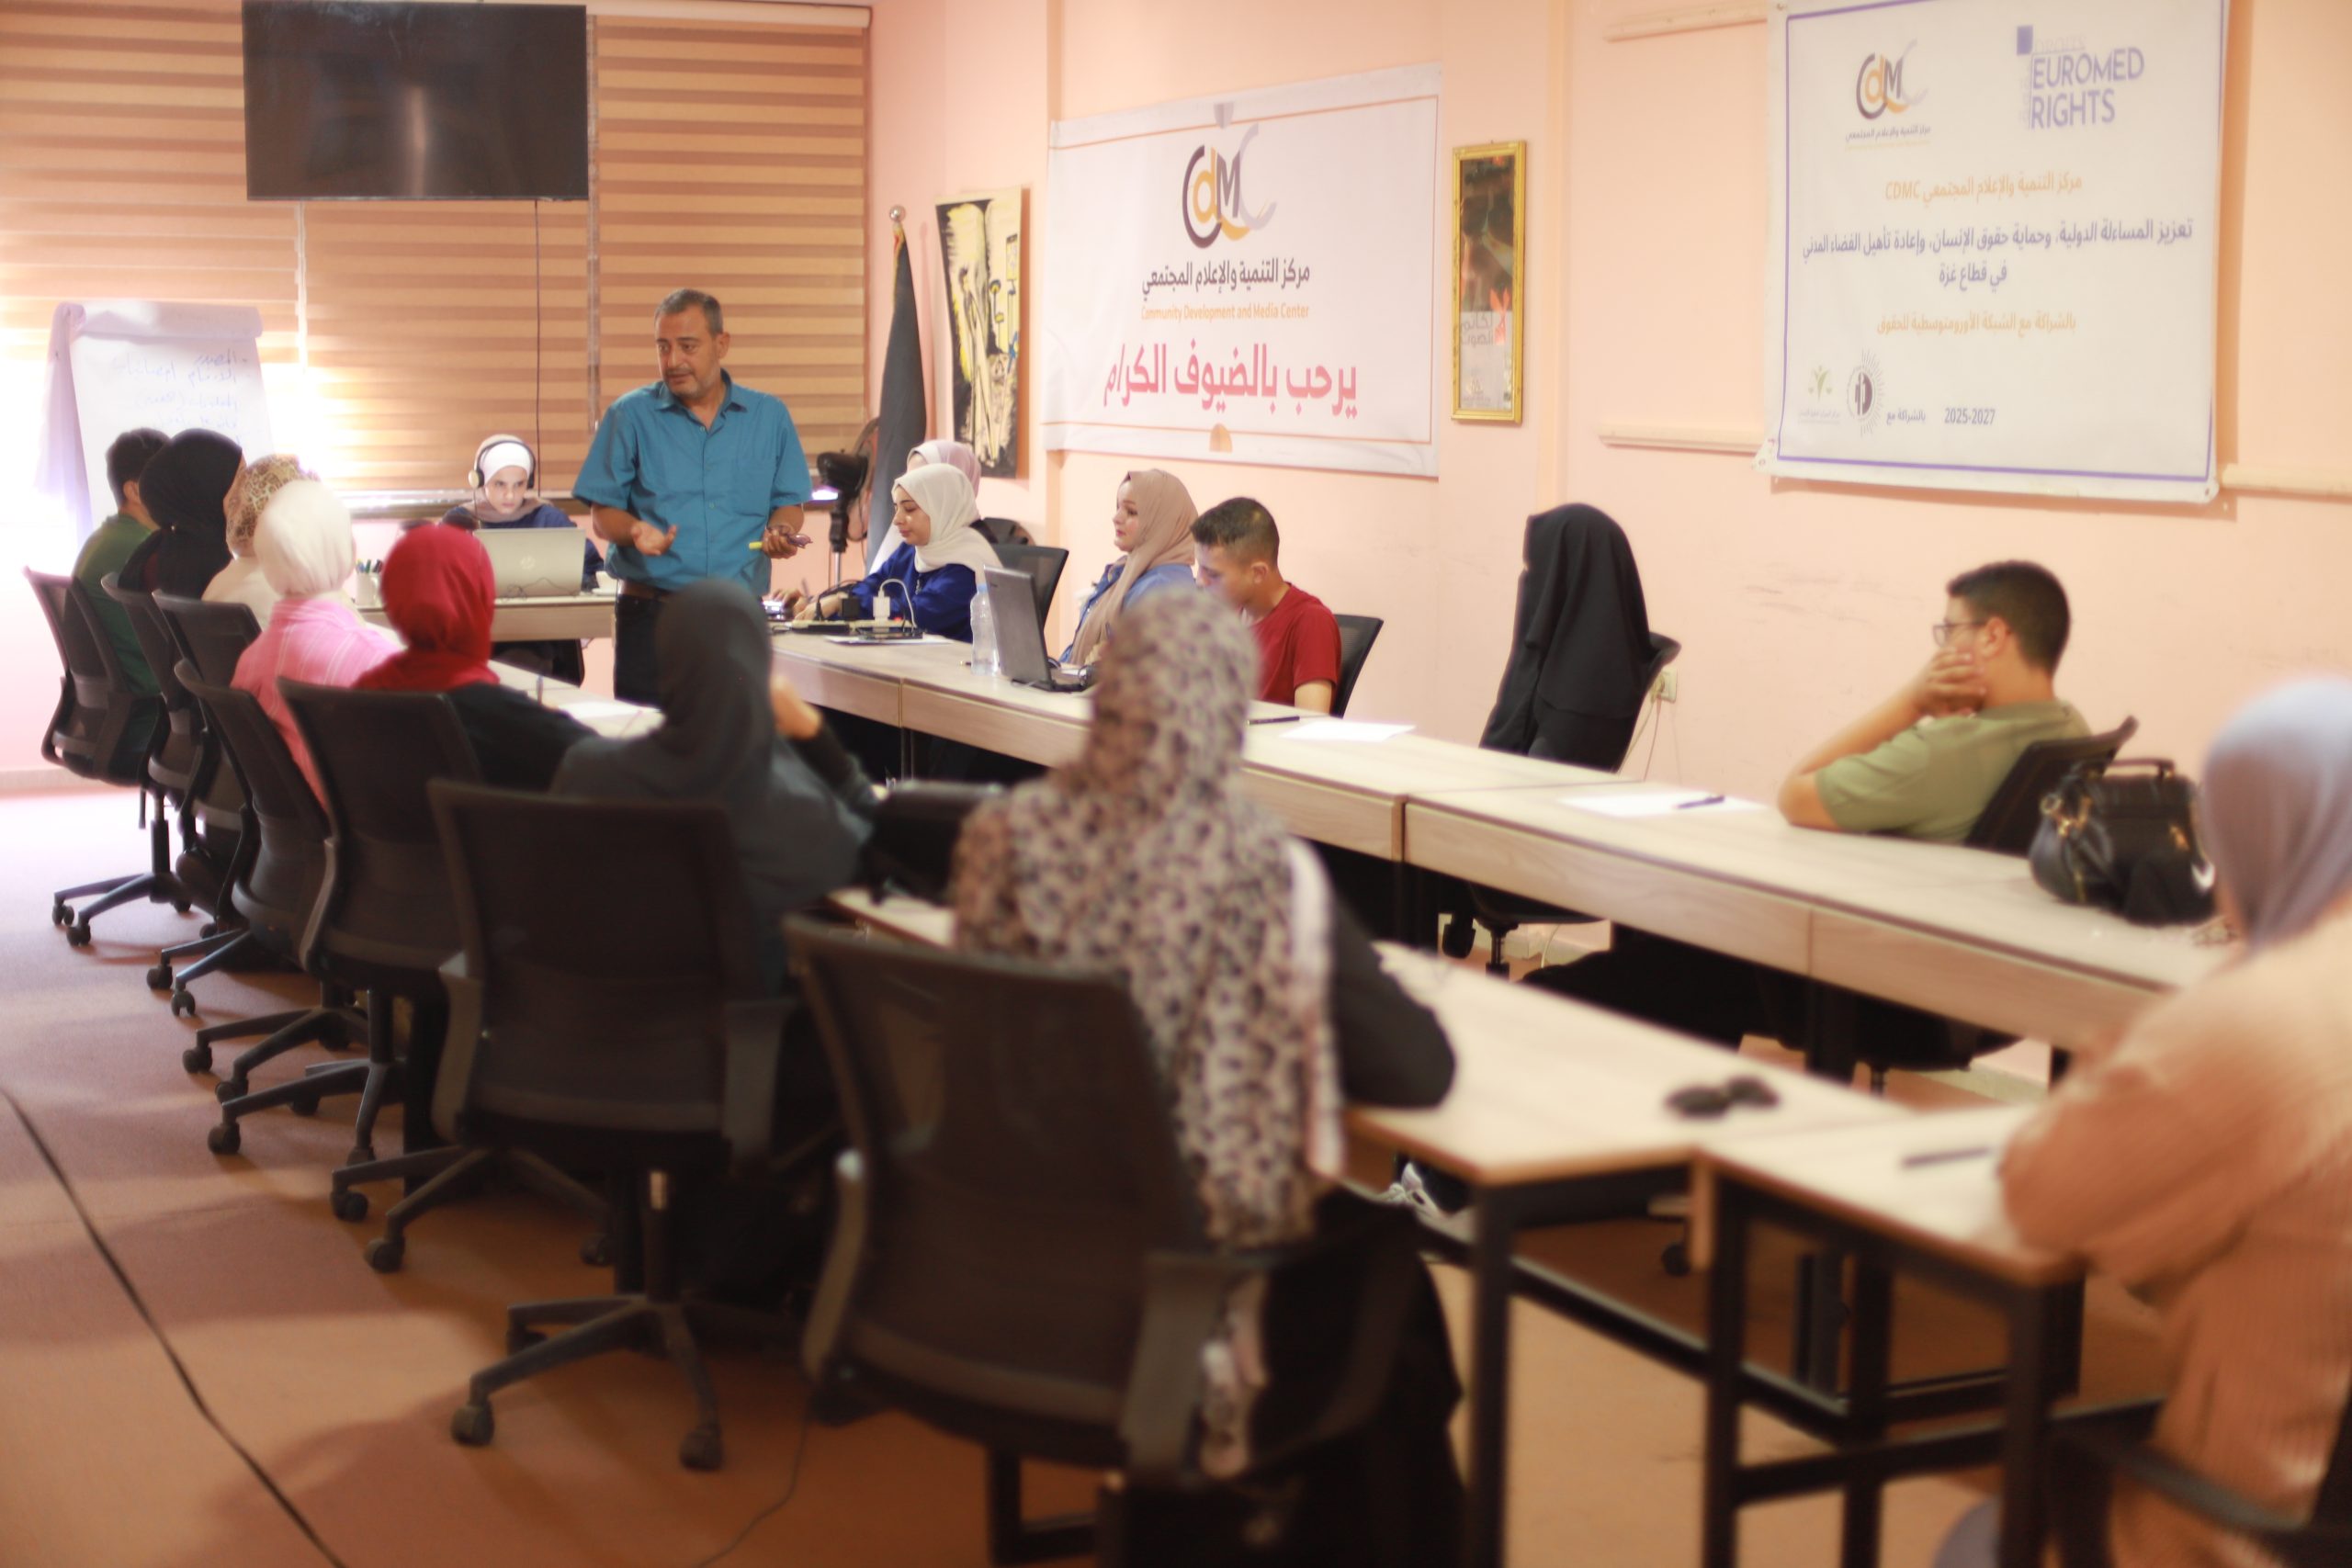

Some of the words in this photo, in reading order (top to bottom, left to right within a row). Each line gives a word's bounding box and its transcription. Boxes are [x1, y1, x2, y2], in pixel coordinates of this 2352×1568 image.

[2032, 47, 2145, 90] EUROMED
[2030, 88, 2116, 130] RIGHTS
[1885, 179, 1920, 200] CDMC
[1923, 175, 1974, 209] المجتمعي
[1976, 174, 2015, 204] والإعلام
[2018, 170, 2054, 198] التنمية
[2057, 171, 2084, 196] مركز
[1830, 231, 1860, 254] الفضاء
[1863, 225, 1891, 256] تأهيل
[1894, 229, 1926, 256] وإعادة
[1977, 227, 2008, 251] حقوق
[2012, 222, 2052, 250] وحماية
[2100, 218, 2154, 242] المساءلة
[2157, 218, 2194, 245] تعزيز
[1142, 261, 1193, 302] المجتمعي
[1195, 259, 1238, 294] والإعلام
[1239, 257, 1279, 291] التنمية
[1281, 257, 1310, 289] مركز
[1939, 262, 1957, 288] غزة
[1960, 261, 1987, 292] قطاع
[1989, 259, 2007, 294] في
[1141, 306, 1182, 323] Community
[1183, 304, 1235, 323] Development
[1238, 302, 1252, 319] and
[1253, 302, 1279, 320] Media
[1281, 302, 1310, 319] Center
[1877, 312, 1909, 335] للحقوق
[1983, 310, 2016, 332] الشبكة
[2034, 310, 2077, 333] بالشراكة
[2018, 316, 2031, 339] مع
[1103, 343, 1167, 408] الكرام
[1174, 337, 1278, 415] بالضيوف
[1286, 364, 1358, 420] يرحب
[1943, 407, 1996, 426] 2025-2027
